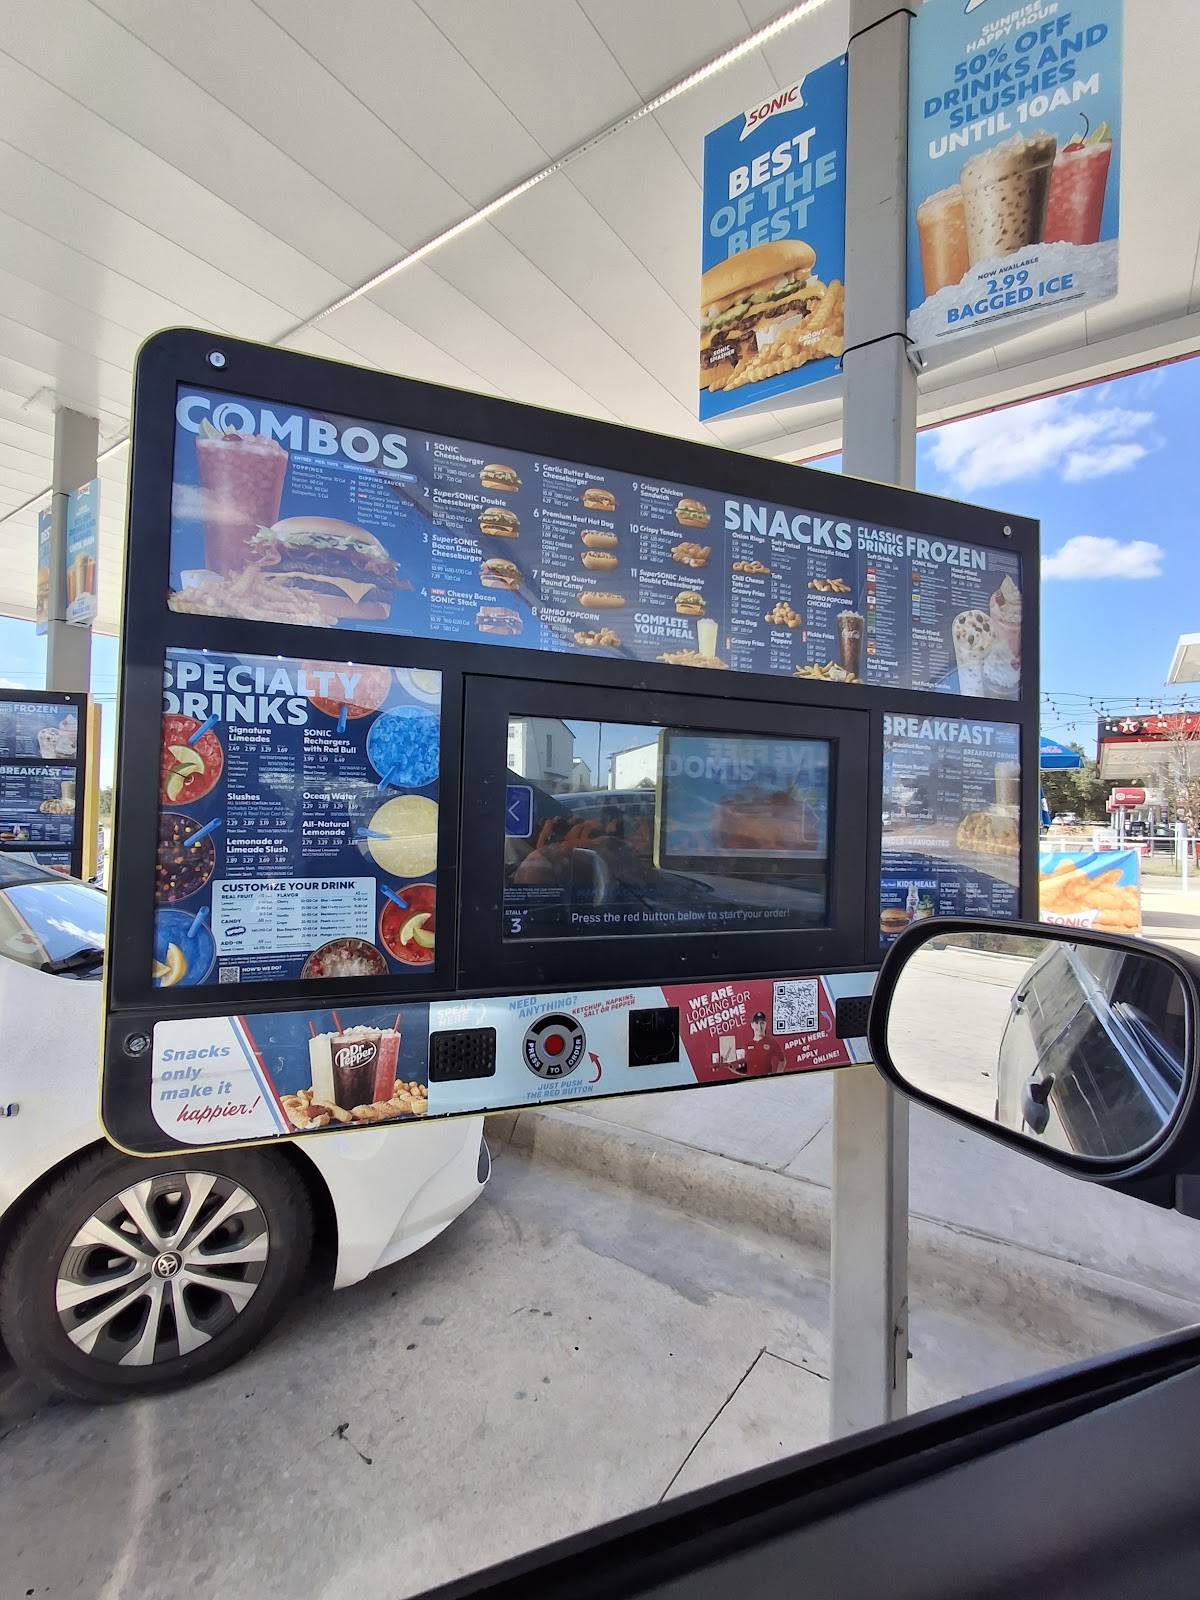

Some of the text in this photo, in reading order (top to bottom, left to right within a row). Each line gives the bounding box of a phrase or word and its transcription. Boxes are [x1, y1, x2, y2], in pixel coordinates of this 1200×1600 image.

[981, 0, 1042, 36] SUNRISE
[966, 3, 1058, 53] HAPPY HOUR
[954, 13, 1072, 83] 50% OFF
[924, 23, 1108, 119] DRINKS AND
[949, 59, 1076, 129] SLUSHES
[747, 86, 799, 127] SONIC
[929, 73, 1100, 159] UNTIL 10AM
[729, 127, 816, 200] BEST
[709, 151, 837, 238] OF THE
[728, 195, 815, 259] BEST
[978, 257, 1039, 280] NOW AVAILABLE
[987, 270, 1029, 295] 2.99
[947, 287, 1034, 324] BAGGED
[1038, 273, 1073, 296] ICE
[713, 345, 730, 356] SONIC
[175, 395, 409, 469] COMBOS
[434, 442, 459, 453] SONIC
[434, 450, 484, 465] Cheeseburger
[534, 463, 605, 482] 5 Garlic Butter Bacon
[543, 471, 588, 485] Cheeseburger
[423, 487, 506, 507] 2 SuperSONIC Double
[632, 482, 683, 497] 9 Crispy Chicken
[640, 490, 670, 501] Sandwich
[433, 496, 483, 510] Cheeseburger
[533, 508, 614, 529] 6 Premium Beef Hot Dog
[724, 500, 852, 551] SNACKS
[630, 523, 683, 538] 10 Crispy Tenders
[858, 527, 903, 545] CLASSIC
[422, 533, 478, 546] 3 SuperSONIC
[432, 542, 482, 554] Bacon Double
[432, 549, 482, 562] Cheeseburger
[858, 538, 904, 558] DRINKS
[906, 537, 986, 570] FROZEN
[532, 570, 597, 585] 7 Footlong Quarter
[541, 578, 584, 591] Pound Coney
[421, 587, 496, 602] 4 Cheesy Bacon
[431, 595, 477, 607] SONIC Stack
[531, 607, 600, 621] 8 JUMBO POPCORN
[540, 615, 572, 624] CHICKEN
[634, 613, 689, 629] COMPLETE
[634, 623, 694, 640] YOUR MEAL
[13, 704, 58, 714] FROZEN
[229, 726, 271, 735] Signature
[229, 734, 270, 742] Limeades
[304, 729, 331, 737] SONIC
[883, 716, 994, 745] BREAKFAST
[304, 737, 350, 746] Rechargers
[0, 766, 62, 776] BREAKFAST
[303, 792, 356, 800] Ocean Water
[222, 883, 286, 892] CUSTOMIZE
[321, 881, 355, 889] DRINK
[572, 913, 600, 923] Press
[604, 913, 620, 922] the
[623, 912, 640, 922] red
[642, 911, 675, 921] button
[678, 911, 705, 920] below
[707, 911, 717, 920] to
[720, 911, 741, 919] start
[743, 910, 761, 920] your
[1046, 917, 1089, 928] SONIC
[511, 918, 522, 933] 3
[509, 997, 536, 1010] NEED
[689, 986, 734, 1010] WE ARE
[519, 996, 577, 1018] ANYTHING?
[572, 1002, 603, 1014] KETCHUP,
[584, 1009, 599, 1017] SALT
[611, 1000, 634, 1010] PEPPER
[687, 991, 750, 1023] LOOKING FOR
[690, 1003, 746, 1034] AWESOME
[710, 1015, 746, 1037] PEOPLE
[350, 1045, 364, 1054] Dr
[785, 1037, 806, 1050] APPLY
[161, 1045, 230, 1061] Snacks
[335, 1047, 373, 1068] Pepper
[528, 1042, 540, 1067] PRESS
[569, 1039, 581, 1065] ORDER
[797, 1049, 818, 1062] APPLY
[813, 1050, 840, 1064] ONLINE!
[161, 1066, 202, 1081] only
[160, 1081, 232, 1100] make it
[527, 1091, 542, 1099] THE
[562, 1086, 593, 1095] BUTTON
[538, 1082, 559, 1090] JUST
[177, 1096, 261, 1124] happier!
